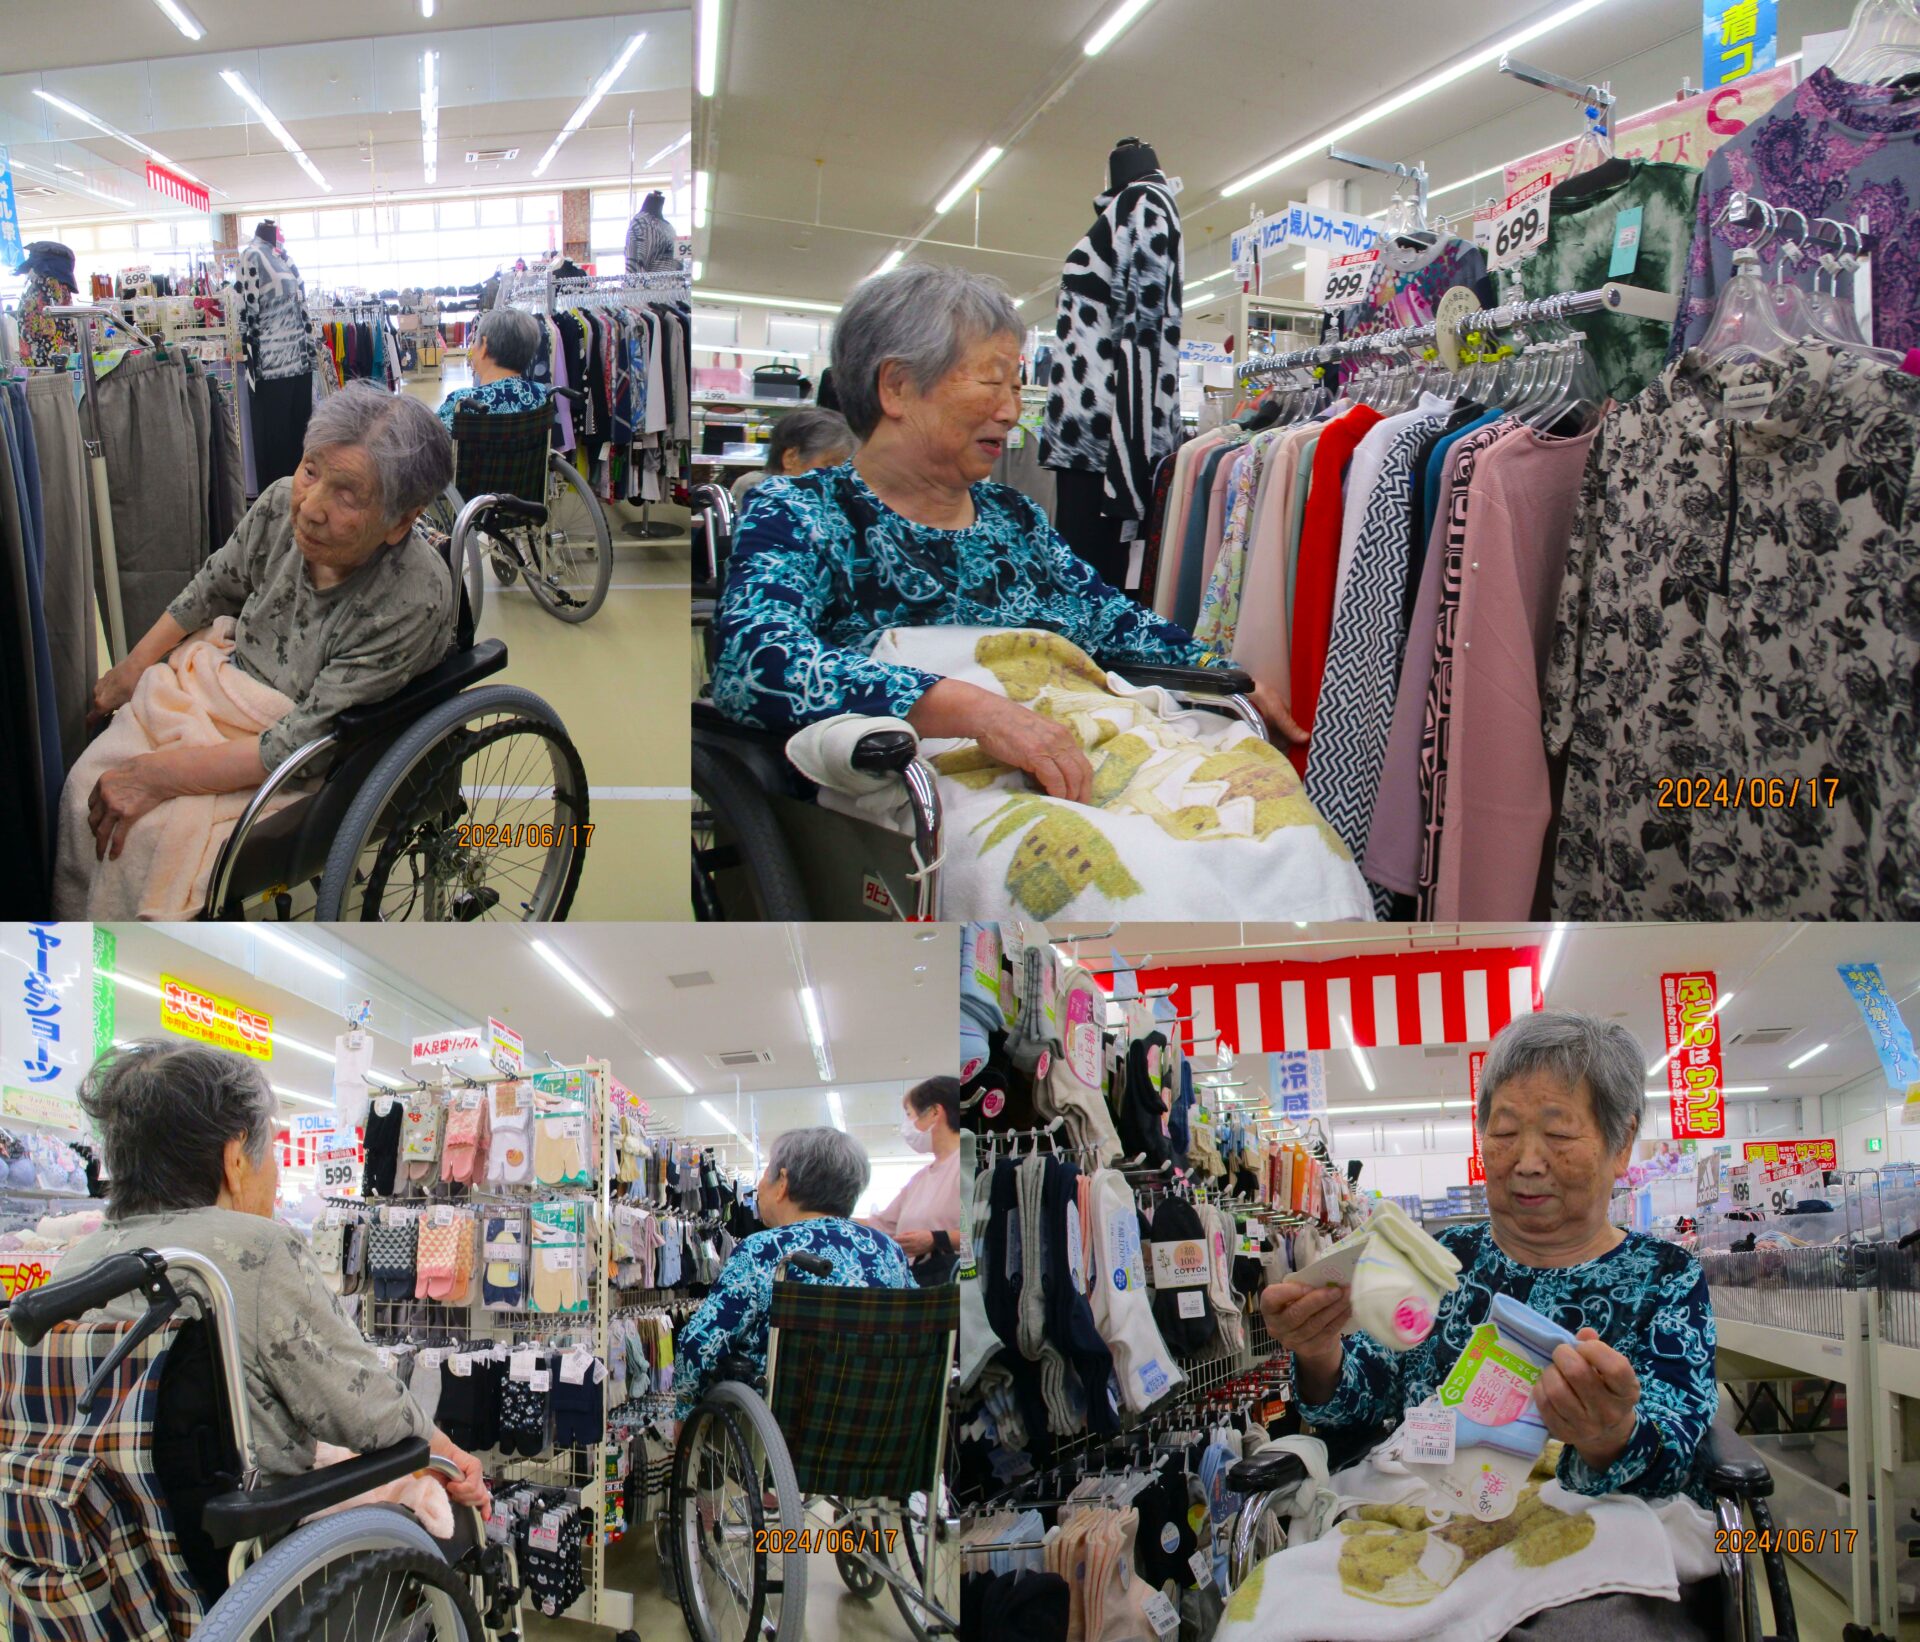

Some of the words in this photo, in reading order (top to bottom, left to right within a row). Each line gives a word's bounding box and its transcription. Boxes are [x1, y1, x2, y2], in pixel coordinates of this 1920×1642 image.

[24, 922, 62, 1083] ャー&ショーツ
[1678, 977, 1721, 1134] ふとんはサンキ
[297, 1116, 334, 1130] TOILE
[1174, 1266, 1207, 1275] COTTON
